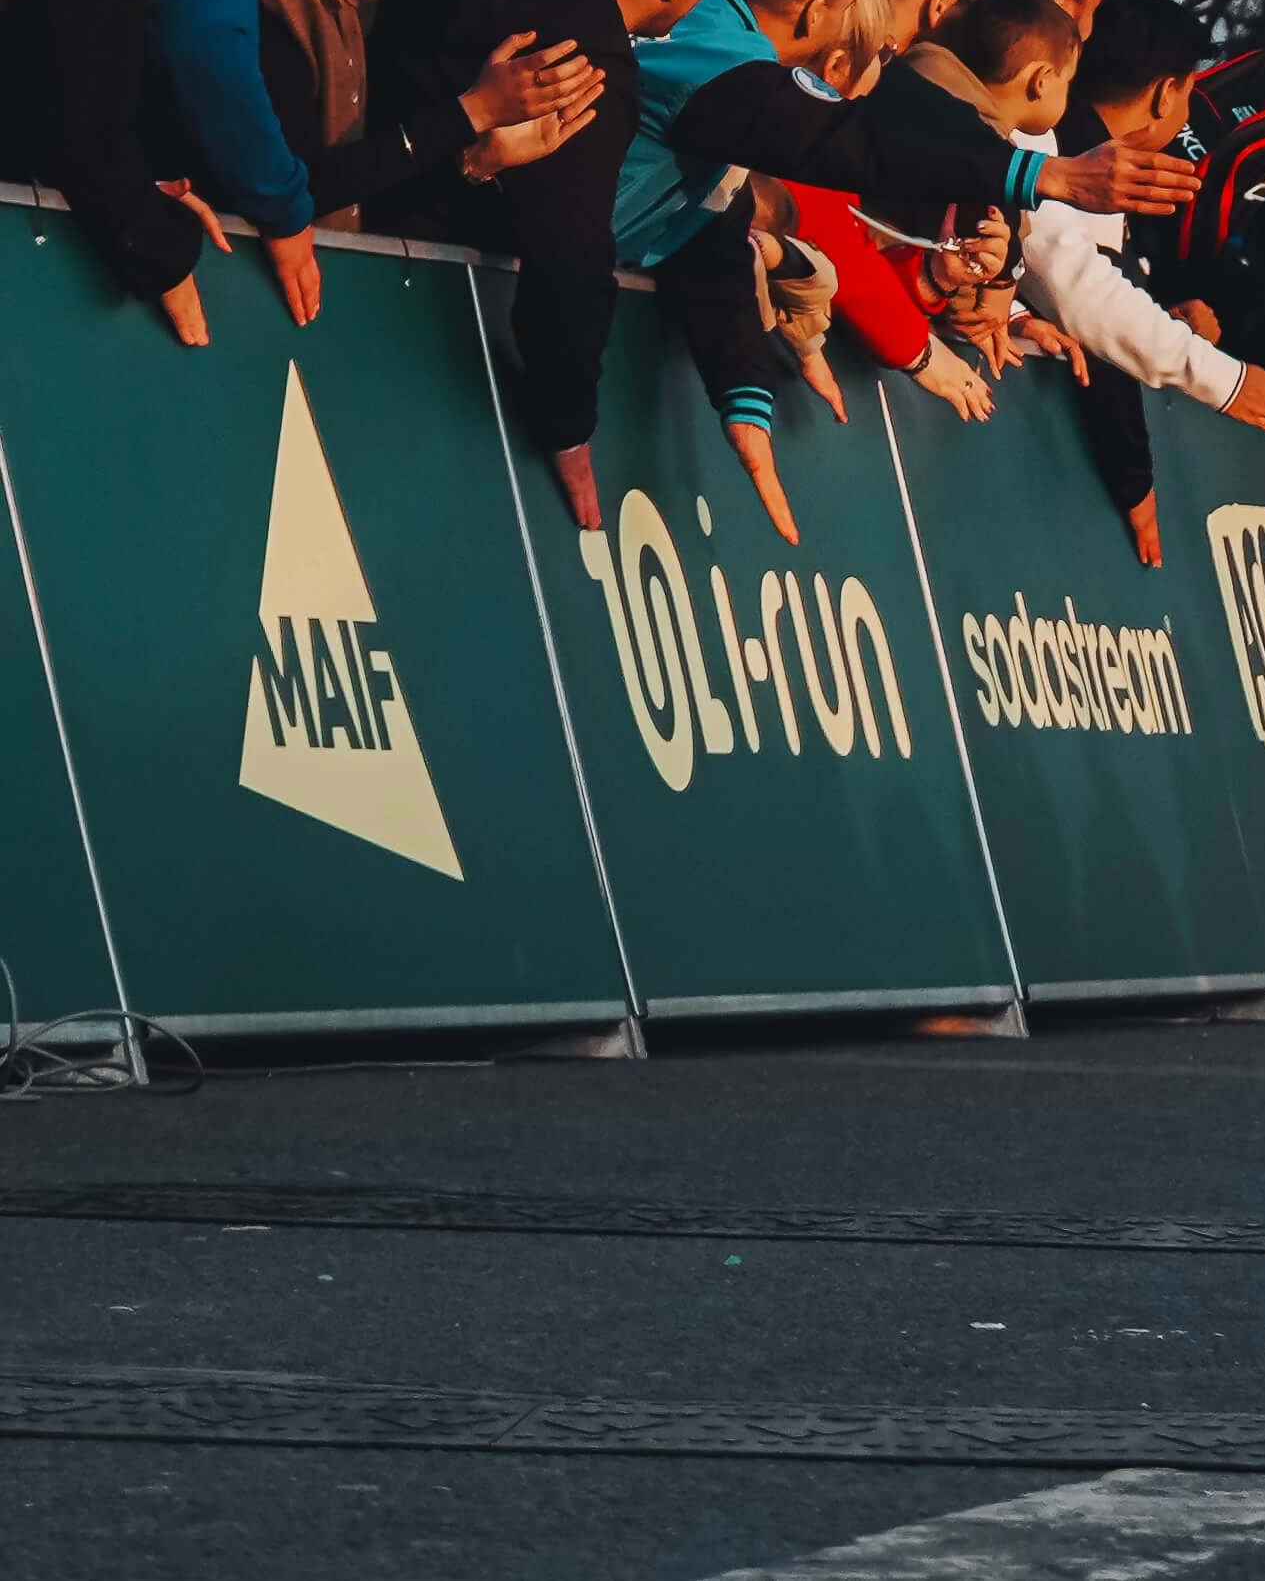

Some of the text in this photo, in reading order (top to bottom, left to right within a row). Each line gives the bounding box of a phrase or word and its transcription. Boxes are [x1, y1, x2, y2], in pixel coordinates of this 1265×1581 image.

[255, 615, 396, 751] MAIF
[696, 494, 913, 760] i-run
[962, 590, 1193, 735] sodastream
